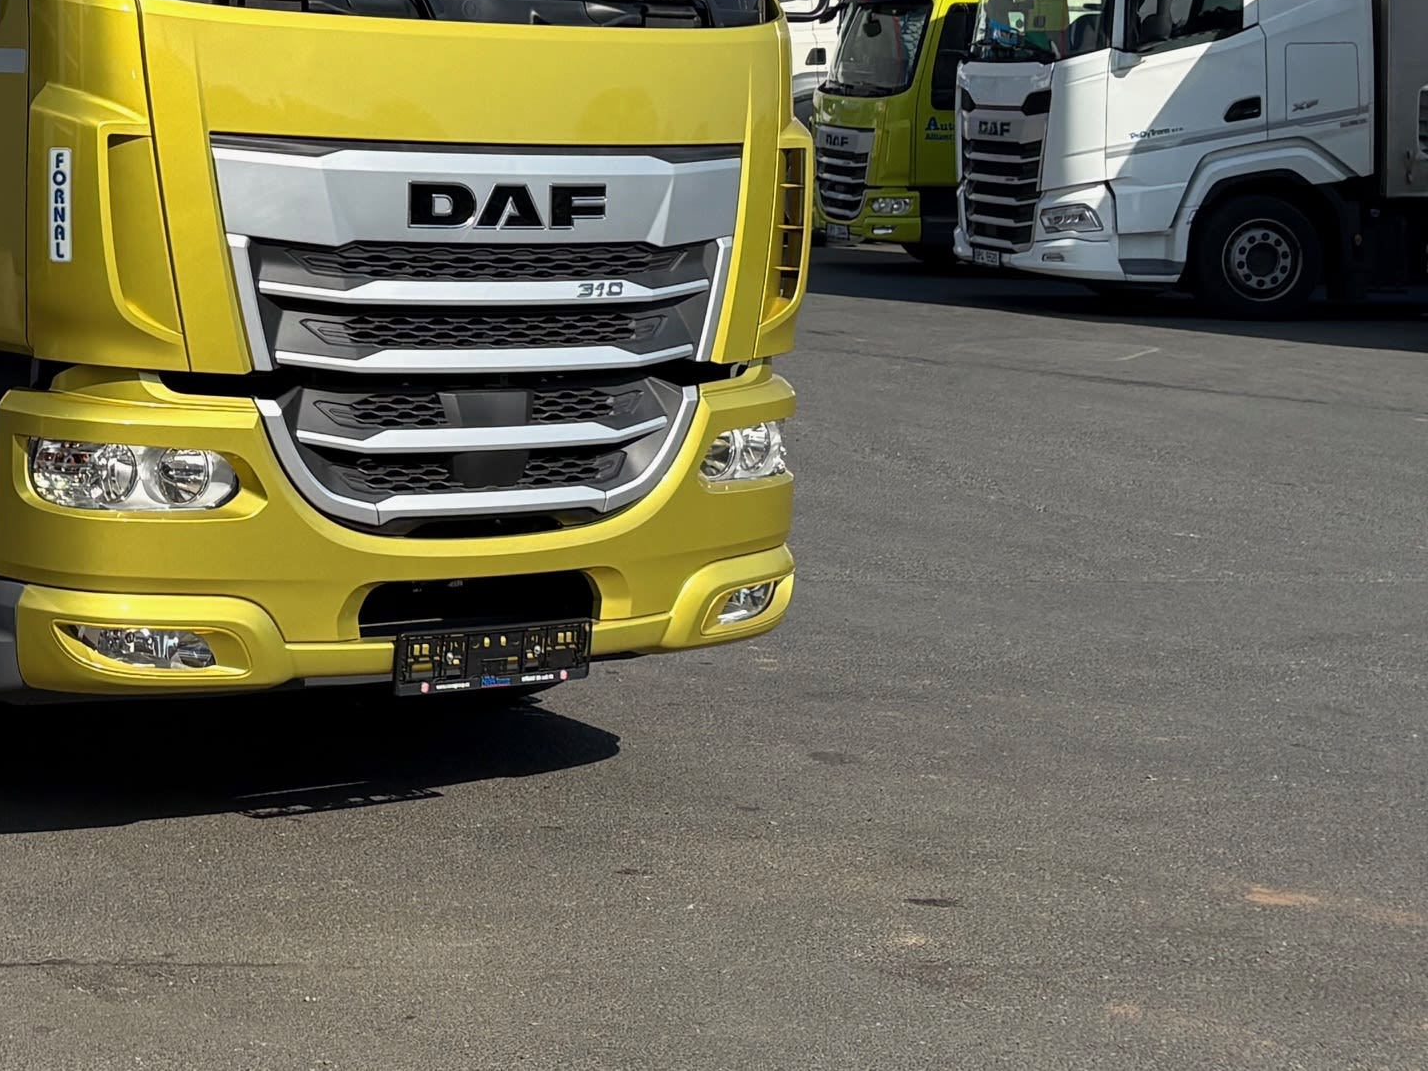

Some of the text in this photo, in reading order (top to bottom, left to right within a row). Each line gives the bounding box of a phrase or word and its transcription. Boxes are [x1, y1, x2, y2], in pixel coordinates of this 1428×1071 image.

[978, 120, 1011, 137] DAF
[825, 134, 849, 148] DAF
[52, 152, 67, 258] FORNAL
[407, 180, 607, 231] DAF
[577, 282, 624, 297] 310
